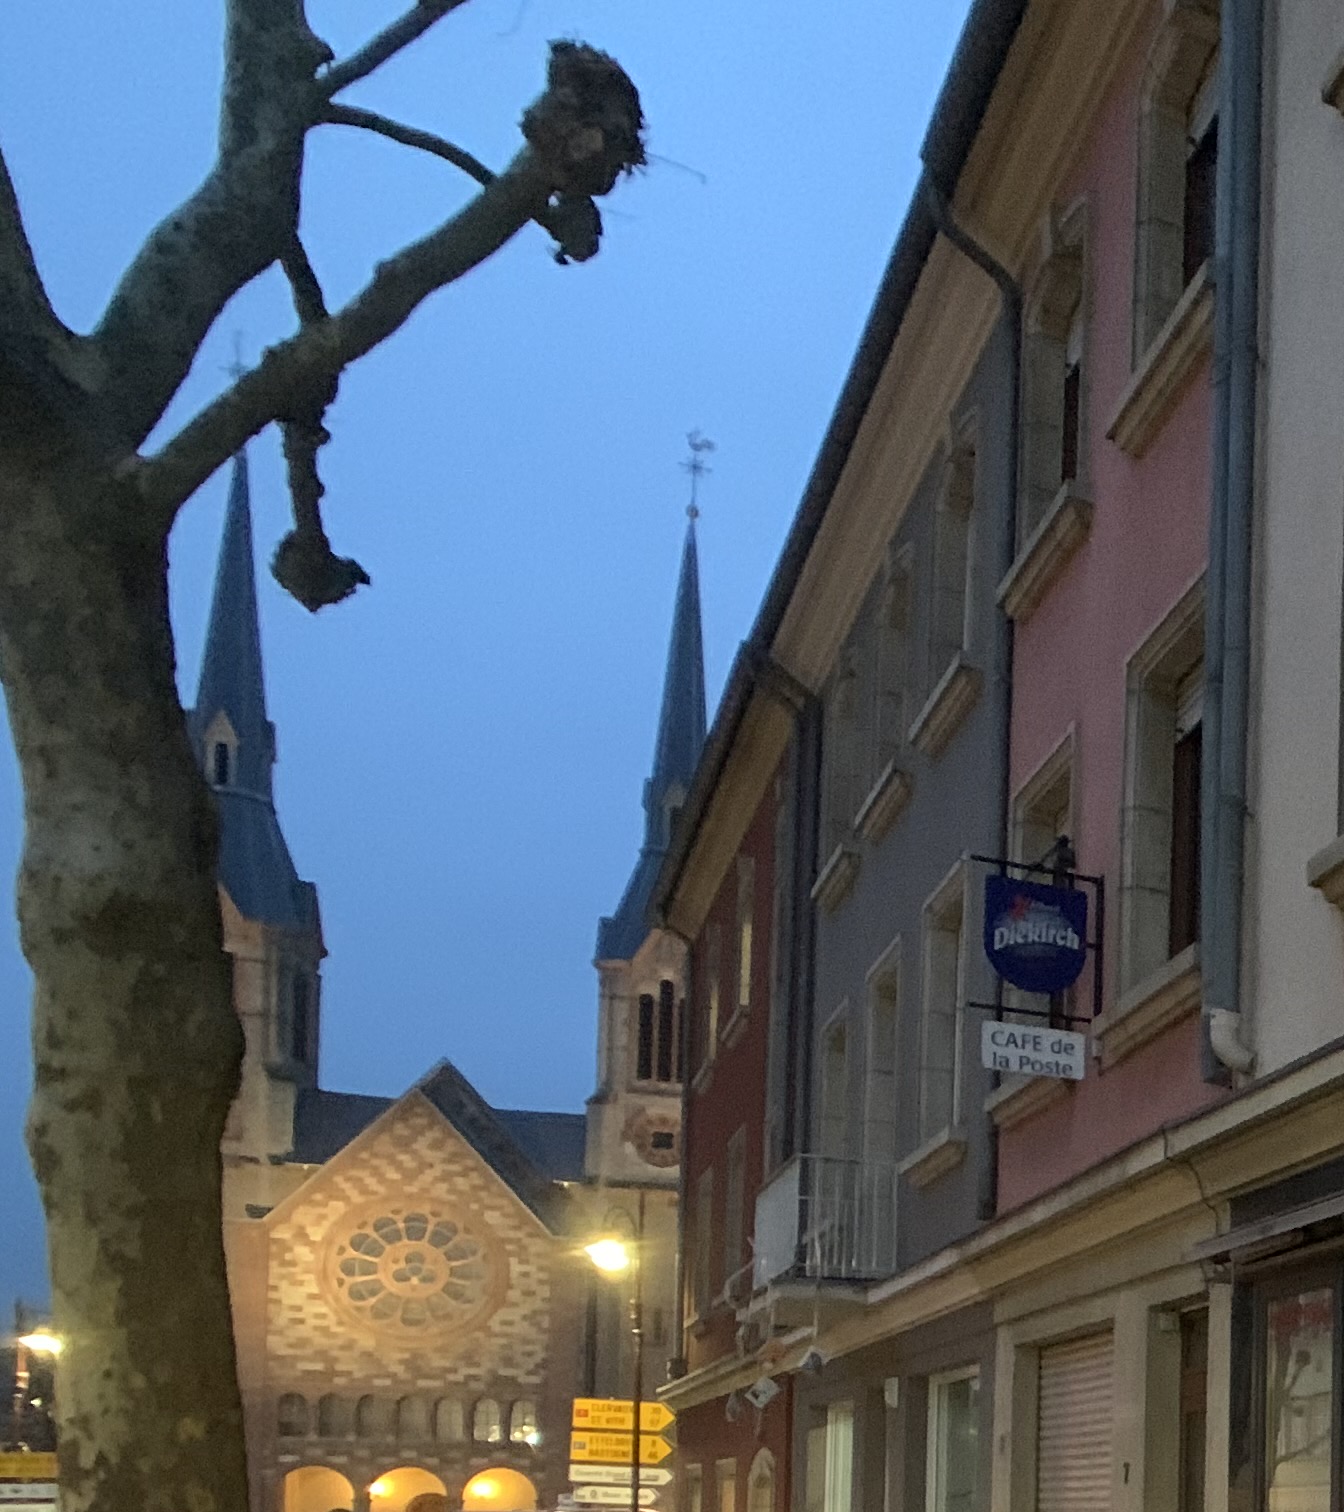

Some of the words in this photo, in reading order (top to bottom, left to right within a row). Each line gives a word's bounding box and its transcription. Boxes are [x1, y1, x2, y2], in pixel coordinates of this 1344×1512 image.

[994, 922, 1080, 950] Diekirch
[991, 1030, 1042, 1050] CAFE
[1050, 1038, 1075, 1056] de
[992, 1052, 1010, 1068] la
[1018, 1055, 1073, 1076] Poste
